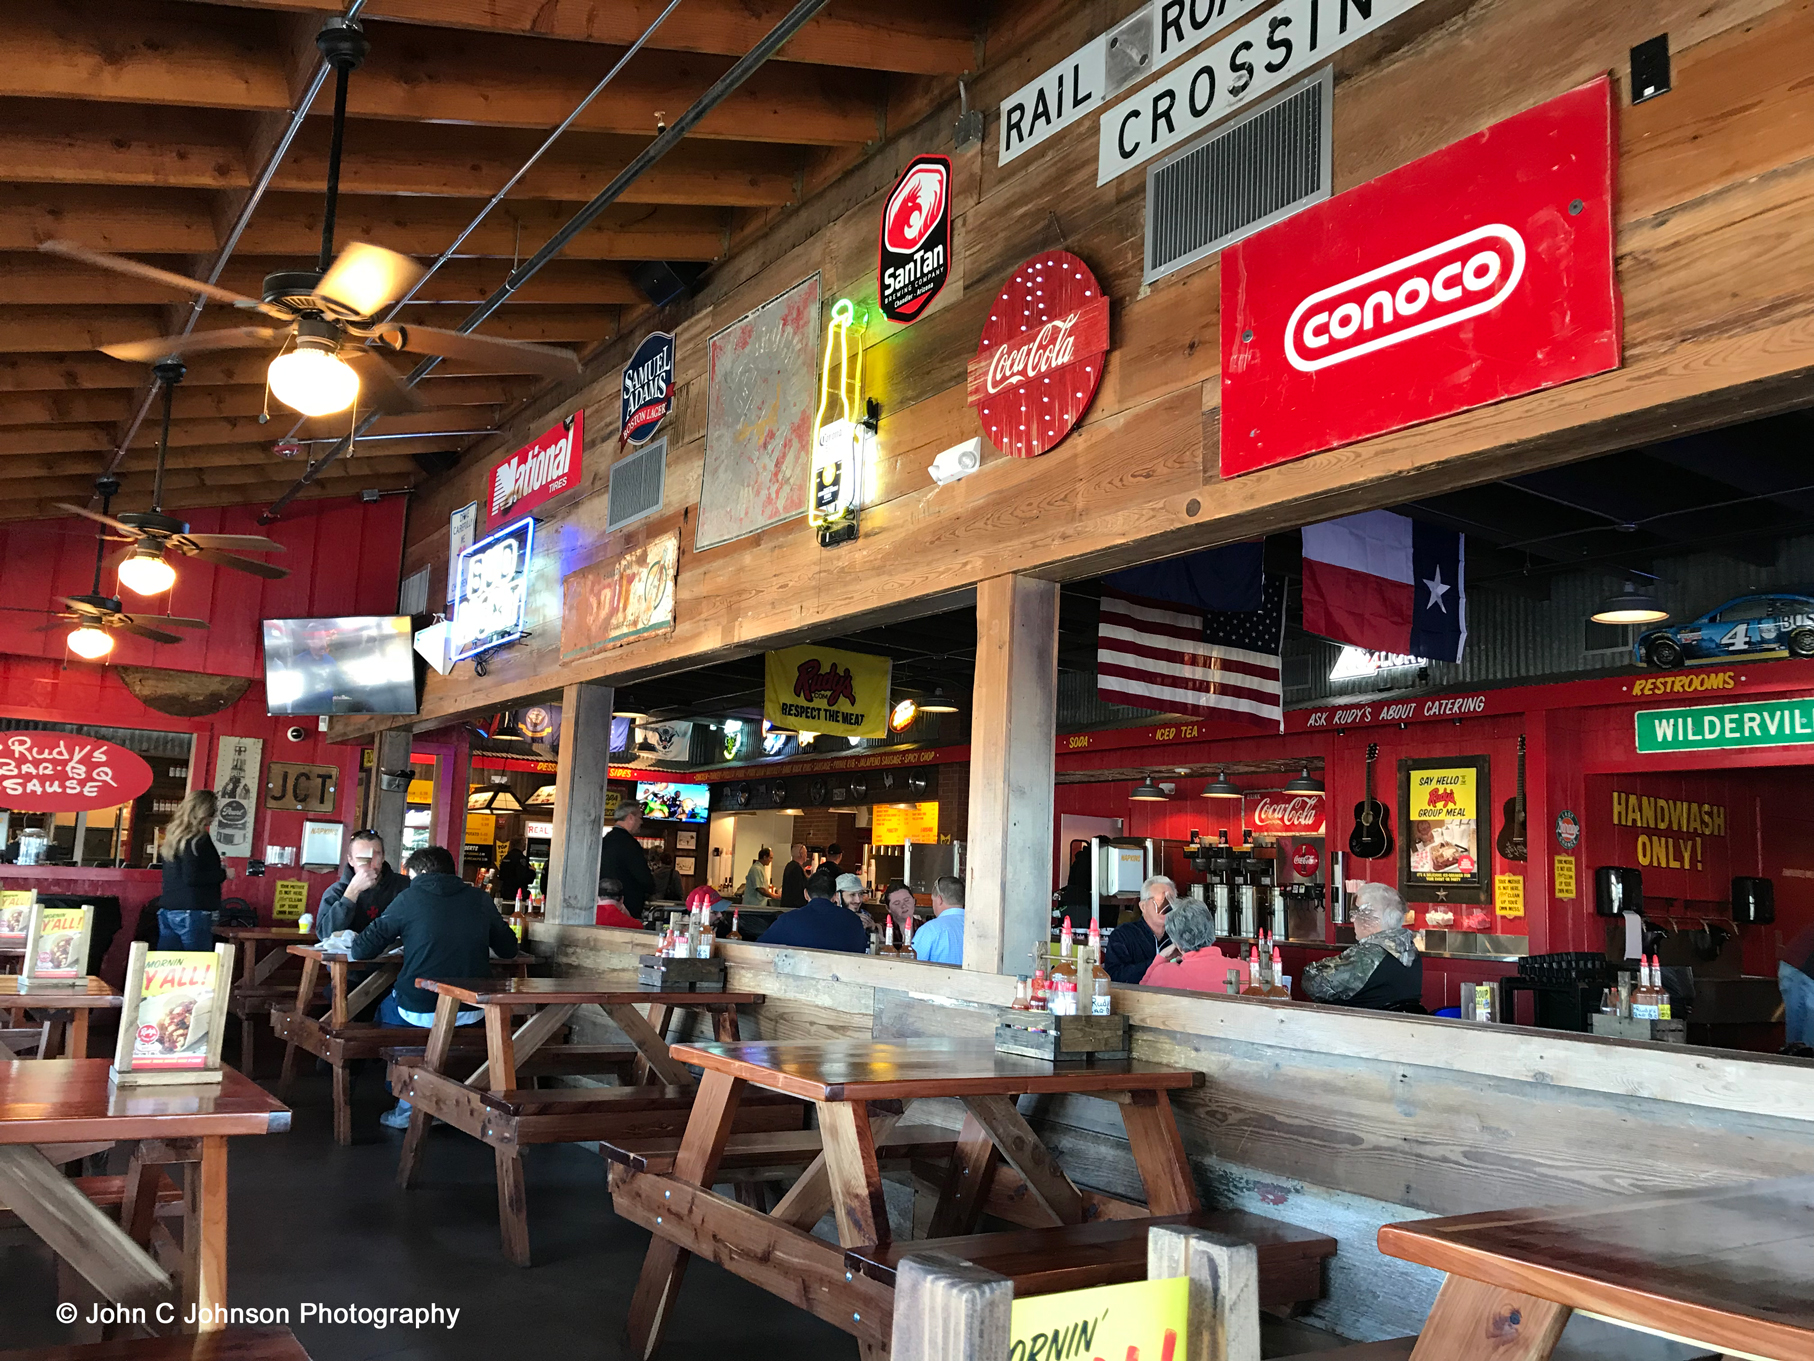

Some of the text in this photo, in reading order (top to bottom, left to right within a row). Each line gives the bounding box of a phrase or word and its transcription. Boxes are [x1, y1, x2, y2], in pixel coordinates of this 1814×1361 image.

[1005, 63, 1093, 152] RAIL
[884, 243, 944, 297] SanTan
[884, 265, 944, 305] BREWING COMPANY
[894, 294, 913, 308] Chandler
[916, 281, 934, 297] Arizona
[986, 309, 1081, 394] Coca-Cola
[623, 345, 671, 400] SAMUEL
[625, 372, 667, 423] ADAMS
[623, 403, 667, 440] BOSTON LAGER
[491, 421, 574, 516] National
[548, 476, 568, 493] TIRES
[1719, 622, 1751, 651] 4
[793, 658, 856, 707] Rudy's
[1632, 671, 1736, 697] RESTROOMS
[781, 702, 865, 727] RESPECT THE MEAT
[1307, 695, 1486, 728] ASK RUDY'S ABOUT CATERING
[1654, 708, 1814, 742] WILDERVIL
[1068, 735, 1089, 749] SODA
[1155, 725, 1198, 742] ICED TEA
[881, 754, 902, 766] SAUSAGE
[904, 751, 935, 763] SPICY CHOP
[2, 778, 103, 797] SAUSE
[270, 770, 333, 805] JCT
[609, 767, 632, 778] SIDES
[1418, 775, 1460, 787] SAY HELLO
[1254, 796, 1319, 826] Coca-Cola
[1418, 807, 1466, 818] GROUP MEAL
[1427, 787, 1457, 808] Rudy's
[1612, 791, 1726, 837] HANDWASH
[1636, 833, 1703, 871] ONLY!
